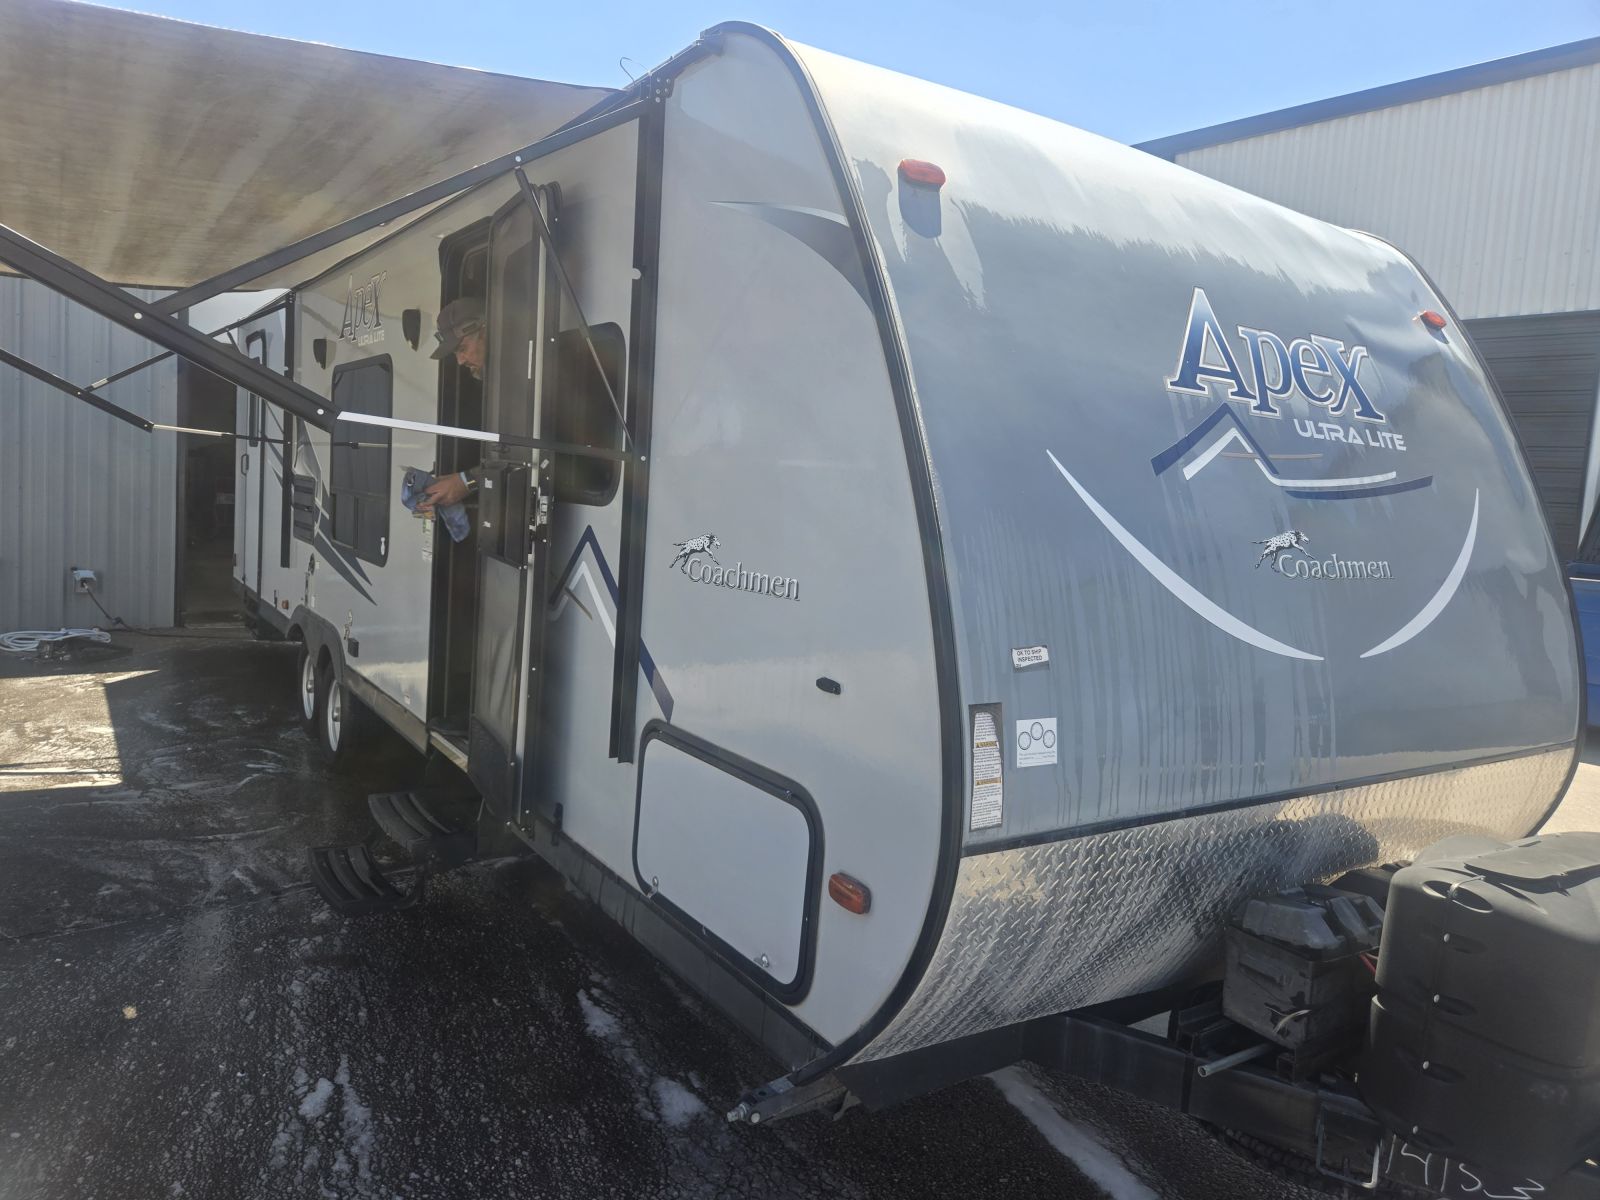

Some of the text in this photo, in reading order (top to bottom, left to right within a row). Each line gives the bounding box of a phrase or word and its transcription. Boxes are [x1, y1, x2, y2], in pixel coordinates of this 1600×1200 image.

[338, 272, 387, 343] Apex
[1164, 286, 1386, 423] Apex
[1293, 418, 1407, 451] ULTRA LITE
[687, 558, 800, 602] Coachmen
[1278, 553, 1394, 580] Coachmen
